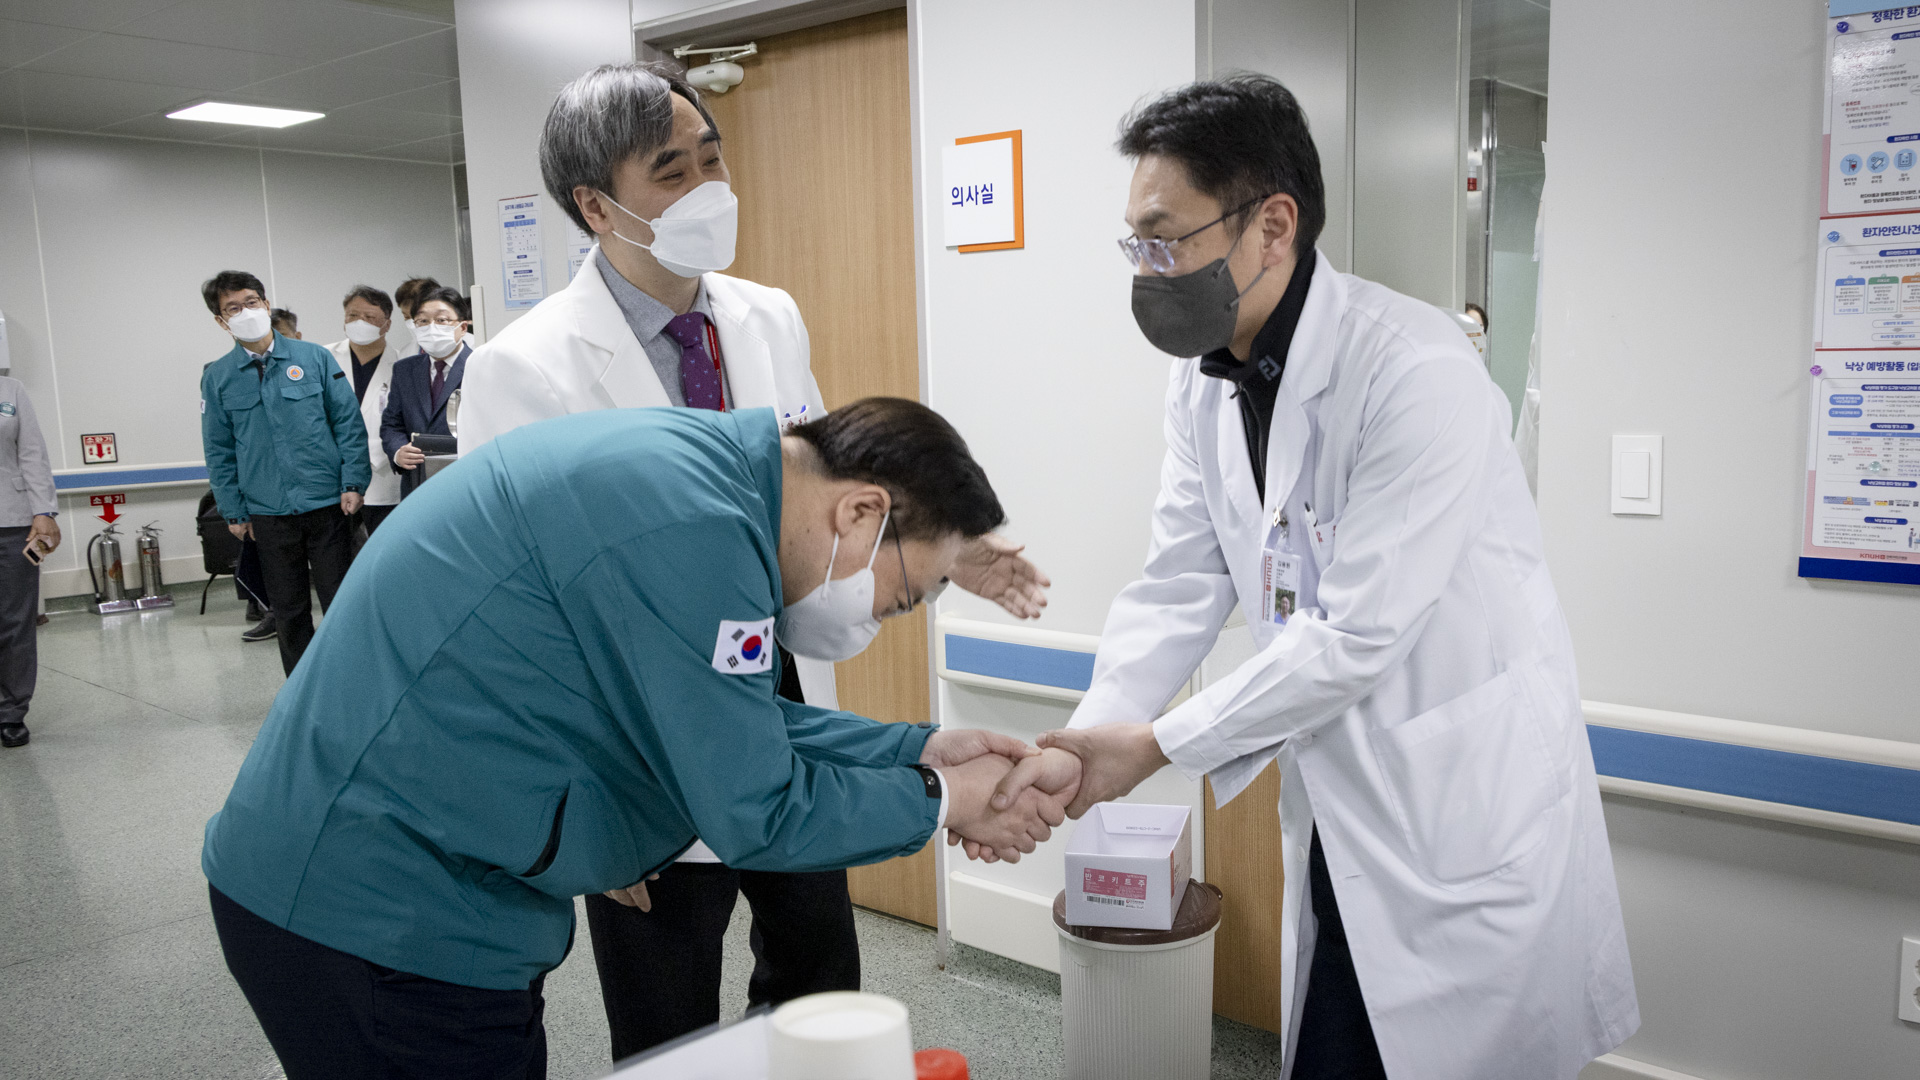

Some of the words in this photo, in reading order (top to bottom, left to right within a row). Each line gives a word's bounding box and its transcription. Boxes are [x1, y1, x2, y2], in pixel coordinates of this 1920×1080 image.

[1872, 10, 1904, 23] 정확한
[1907, 7, 1920, 19] 환
[952, 182, 994, 207] 의사실
[1862, 224, 1920, 238] 환자안전사건
[1845, 362, 1865, 372] 낙상
[1866, 362, 1905, 372] 예방활동
[1907, 362, 1920, 372] (입
[92, 495, 123, 504] 소화기
